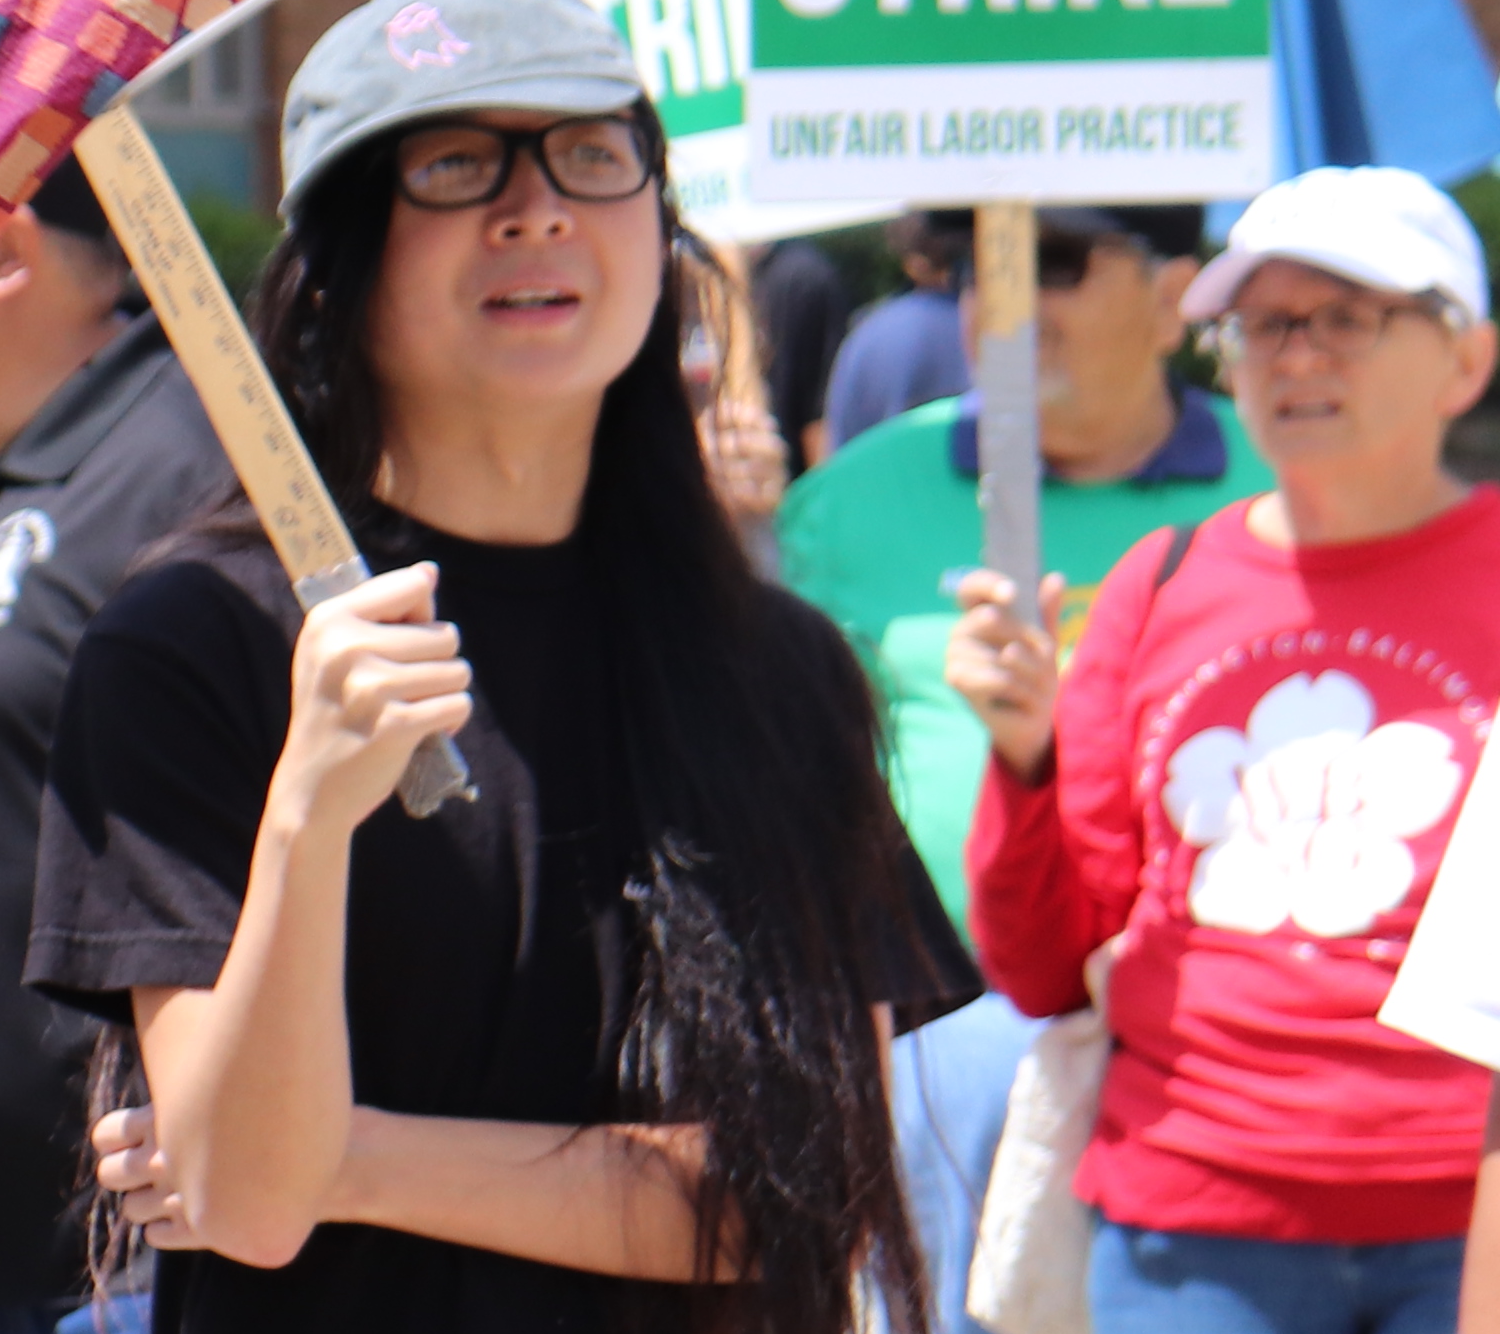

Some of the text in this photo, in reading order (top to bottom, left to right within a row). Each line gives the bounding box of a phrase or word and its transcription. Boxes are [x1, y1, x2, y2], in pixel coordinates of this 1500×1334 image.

[769, 103, 1245, 159] UNFAIR LABOR PRACTICE
